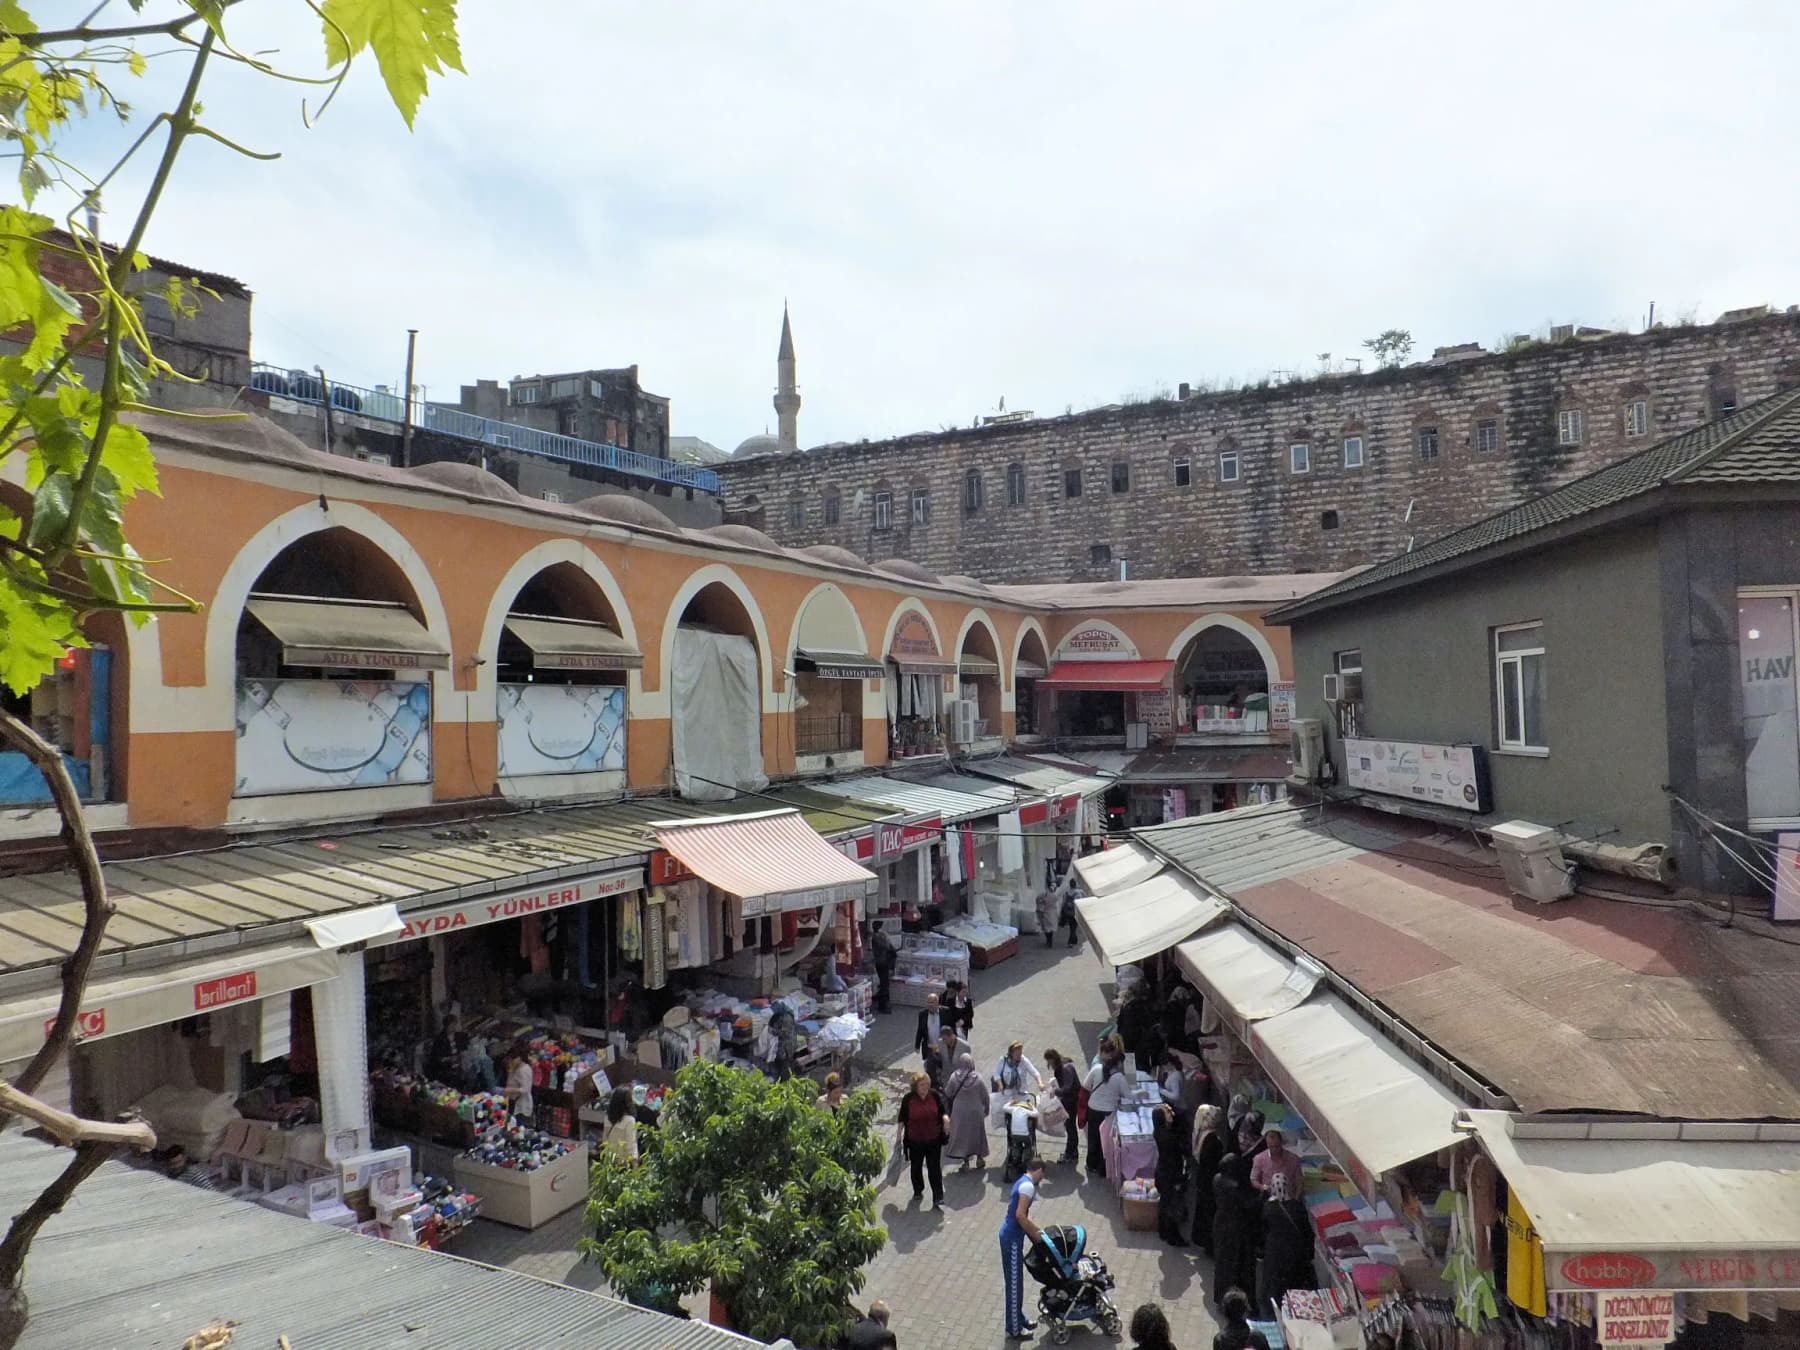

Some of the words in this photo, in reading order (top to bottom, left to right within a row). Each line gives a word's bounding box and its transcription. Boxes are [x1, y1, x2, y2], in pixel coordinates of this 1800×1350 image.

[881, 828, 902, 853] TAC
[398, 912, 467, 938] AYDA
[486, 884, 581, 919] YÜNLERİ
[199, 974, 251, 1007] brillant
